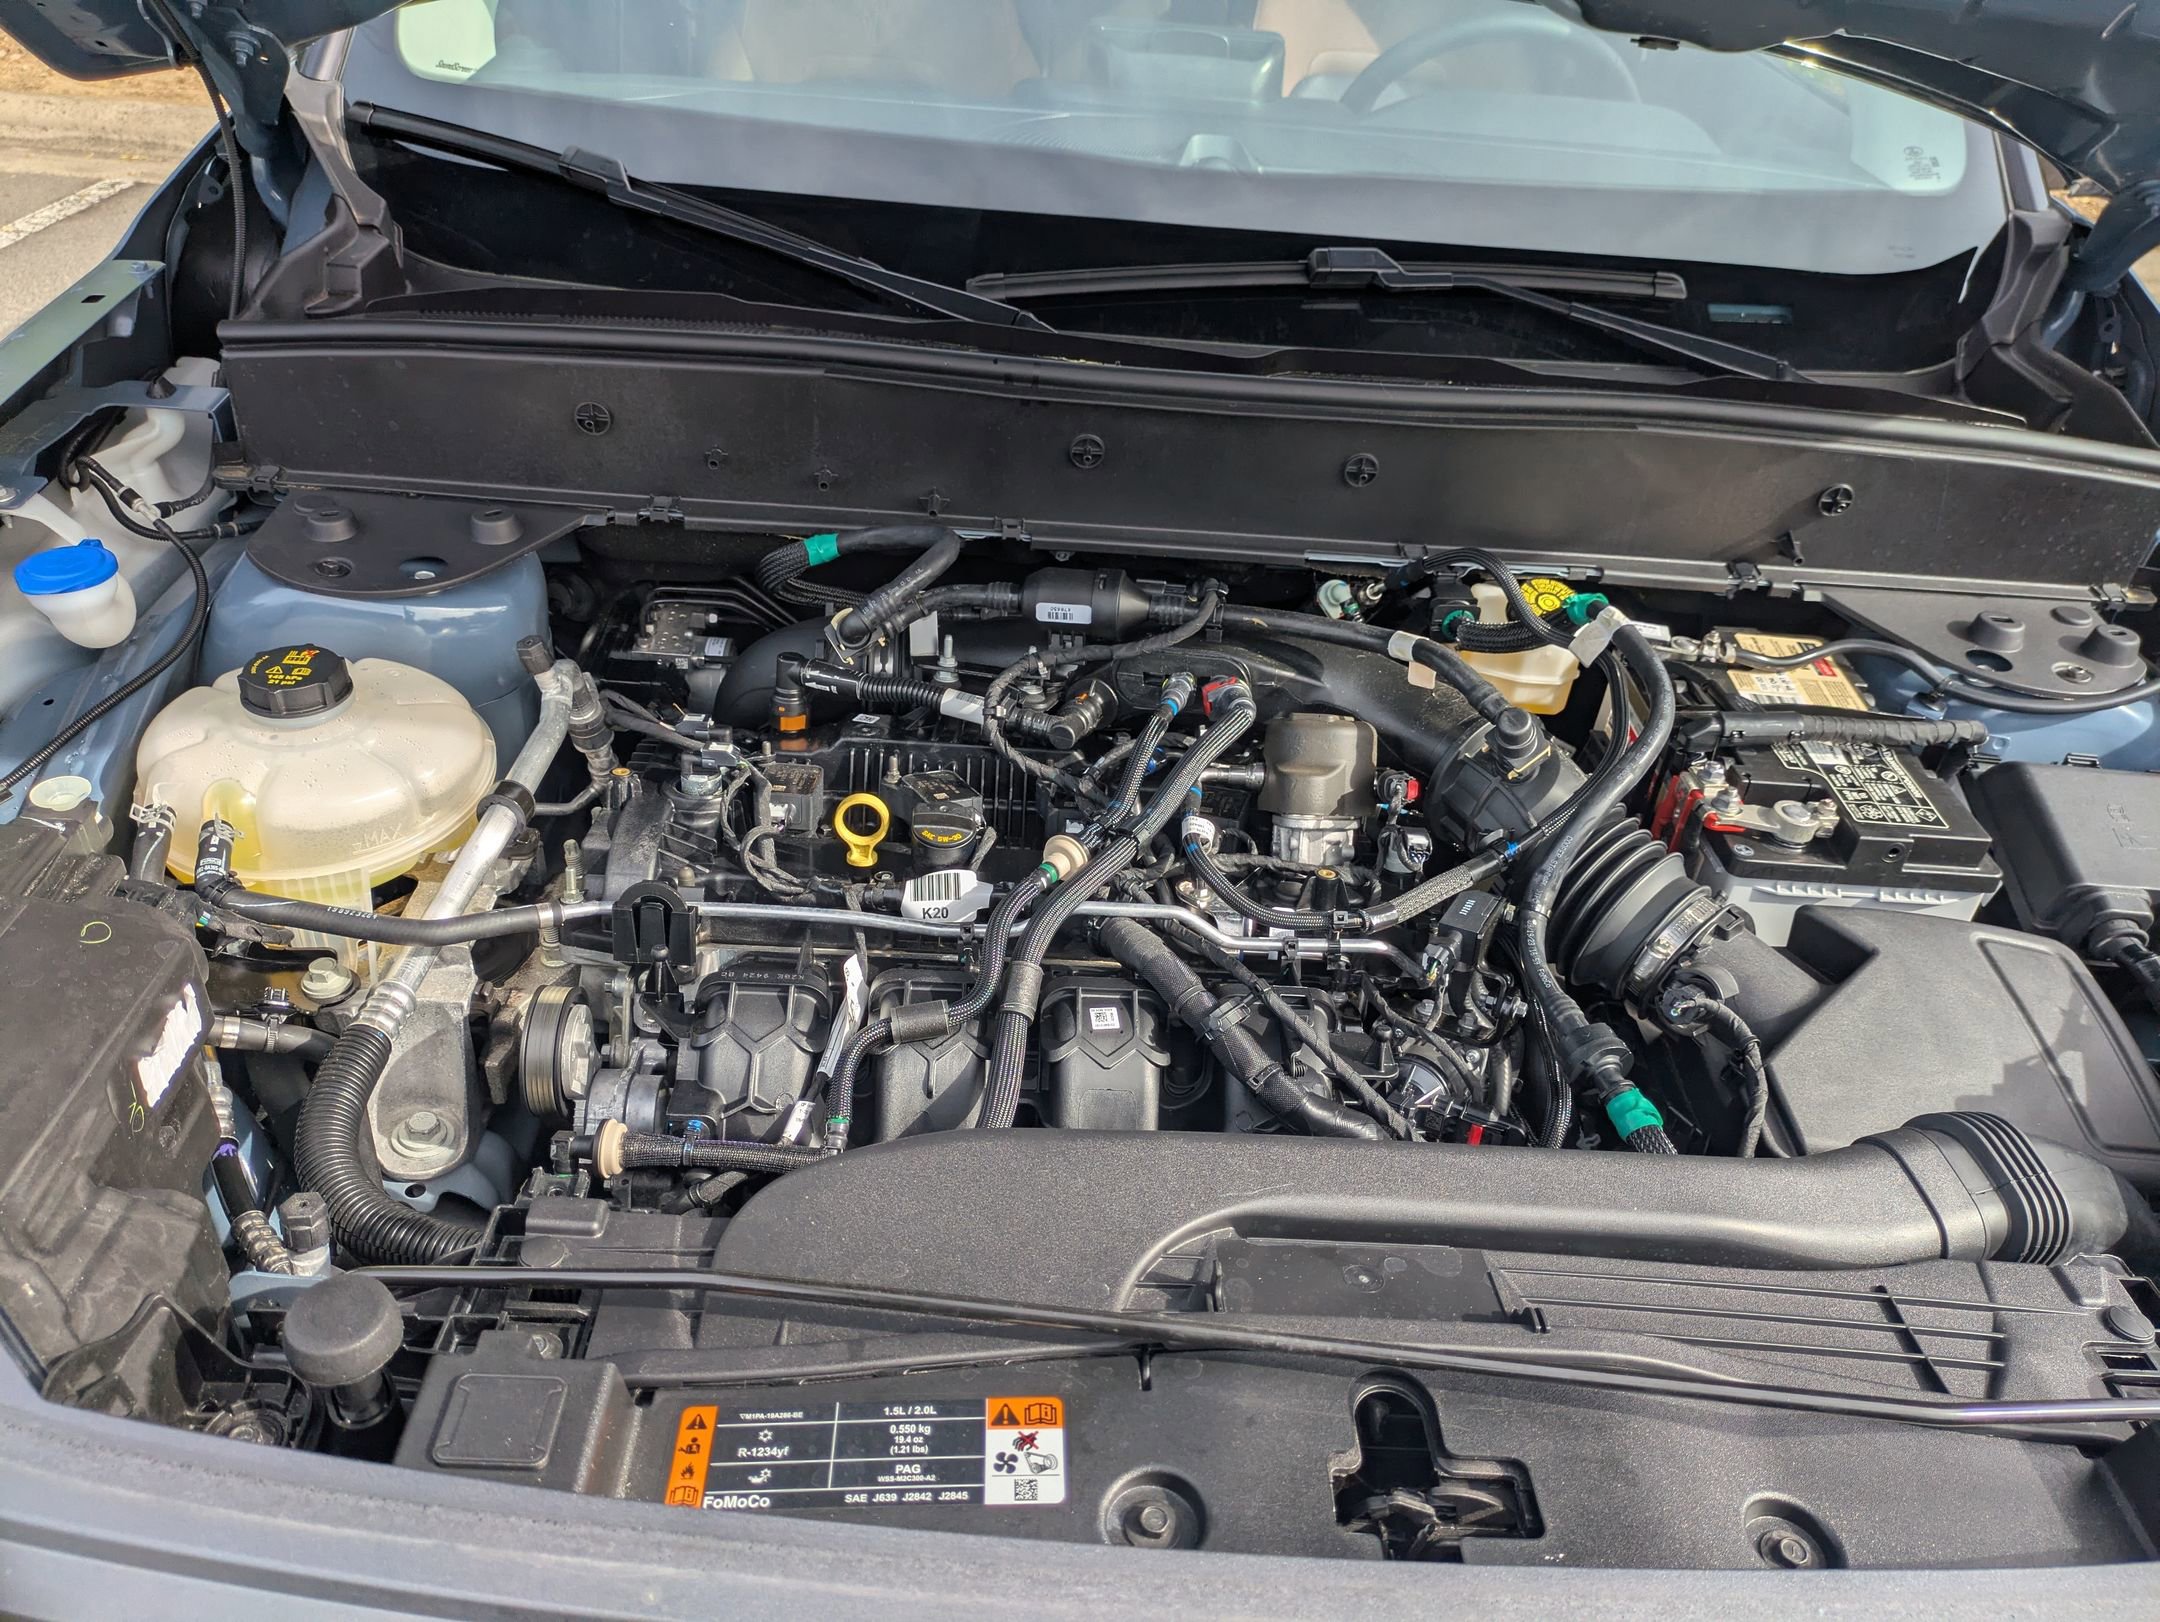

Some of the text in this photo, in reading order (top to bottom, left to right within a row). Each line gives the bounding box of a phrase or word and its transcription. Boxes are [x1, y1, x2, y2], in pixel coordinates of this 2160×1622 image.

[364, 822, 406, 848] MAX
[921, 830, 962, 843] SAE 5W-30
[922, 907, 949, 919] K20
[1536, 968, 1552, 989] FoMoCo
[883, 1405, 937, 1416] 1.5L / 2.0L
[890, 1423, 931, 1436] 0.550 kg
[894, 1435, 911, 1443] 19.4
[737, 1446, 790, 1458] R-1234yf
[890, 1444, 929, 1455] (1.21 lbs)
[895, 1464, 921, 1475] PAG
[702, 1495, 771, 1509] FoMoCo
[844, 1491, 969, 1503] SAE J639 J2842 J2845
